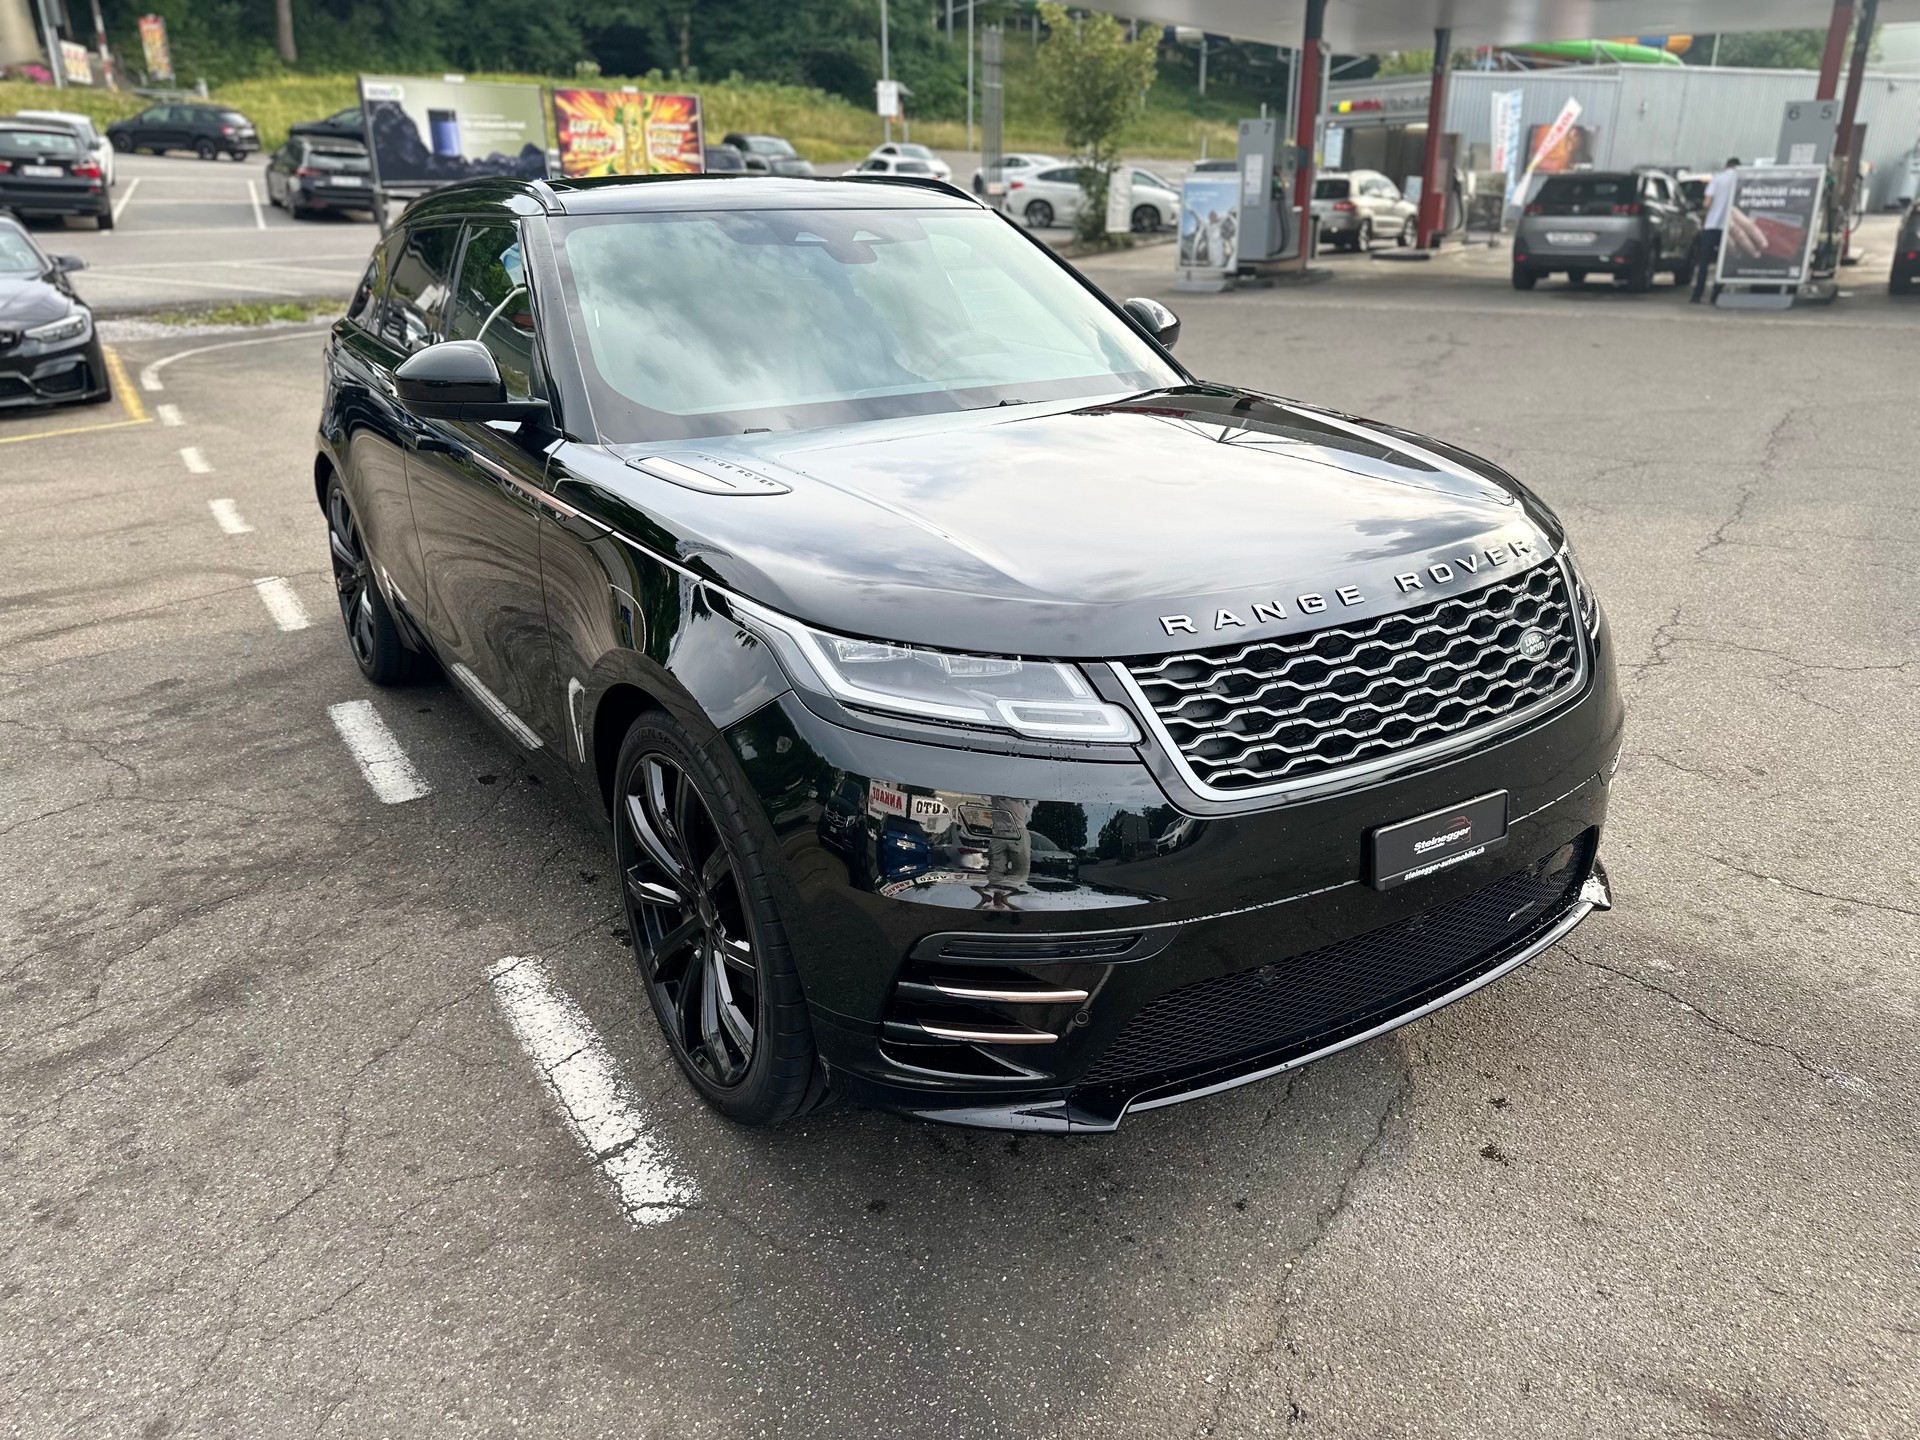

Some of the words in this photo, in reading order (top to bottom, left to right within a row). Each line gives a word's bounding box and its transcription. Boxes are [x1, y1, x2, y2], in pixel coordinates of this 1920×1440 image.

[1788, 106, 1800, 121] 6
[1821, 105, 1833, 120] 5
[1738, 198, 1786, 208] erfahren
[1741, 185, 1787, 197] Mobilität
[1789, 186, 1811, 197] neu
[697, 455, 734, 470] RANGE
[736, 469, 776, 487] ROVER
[1158, 584, 1366, 636] RANGE
[1393, 539, 1533, 593] ROVER
[1413, 826, 1471, 852] Steinegger
[1404, 846, 1486, 881] steinegger-automobile.ch
